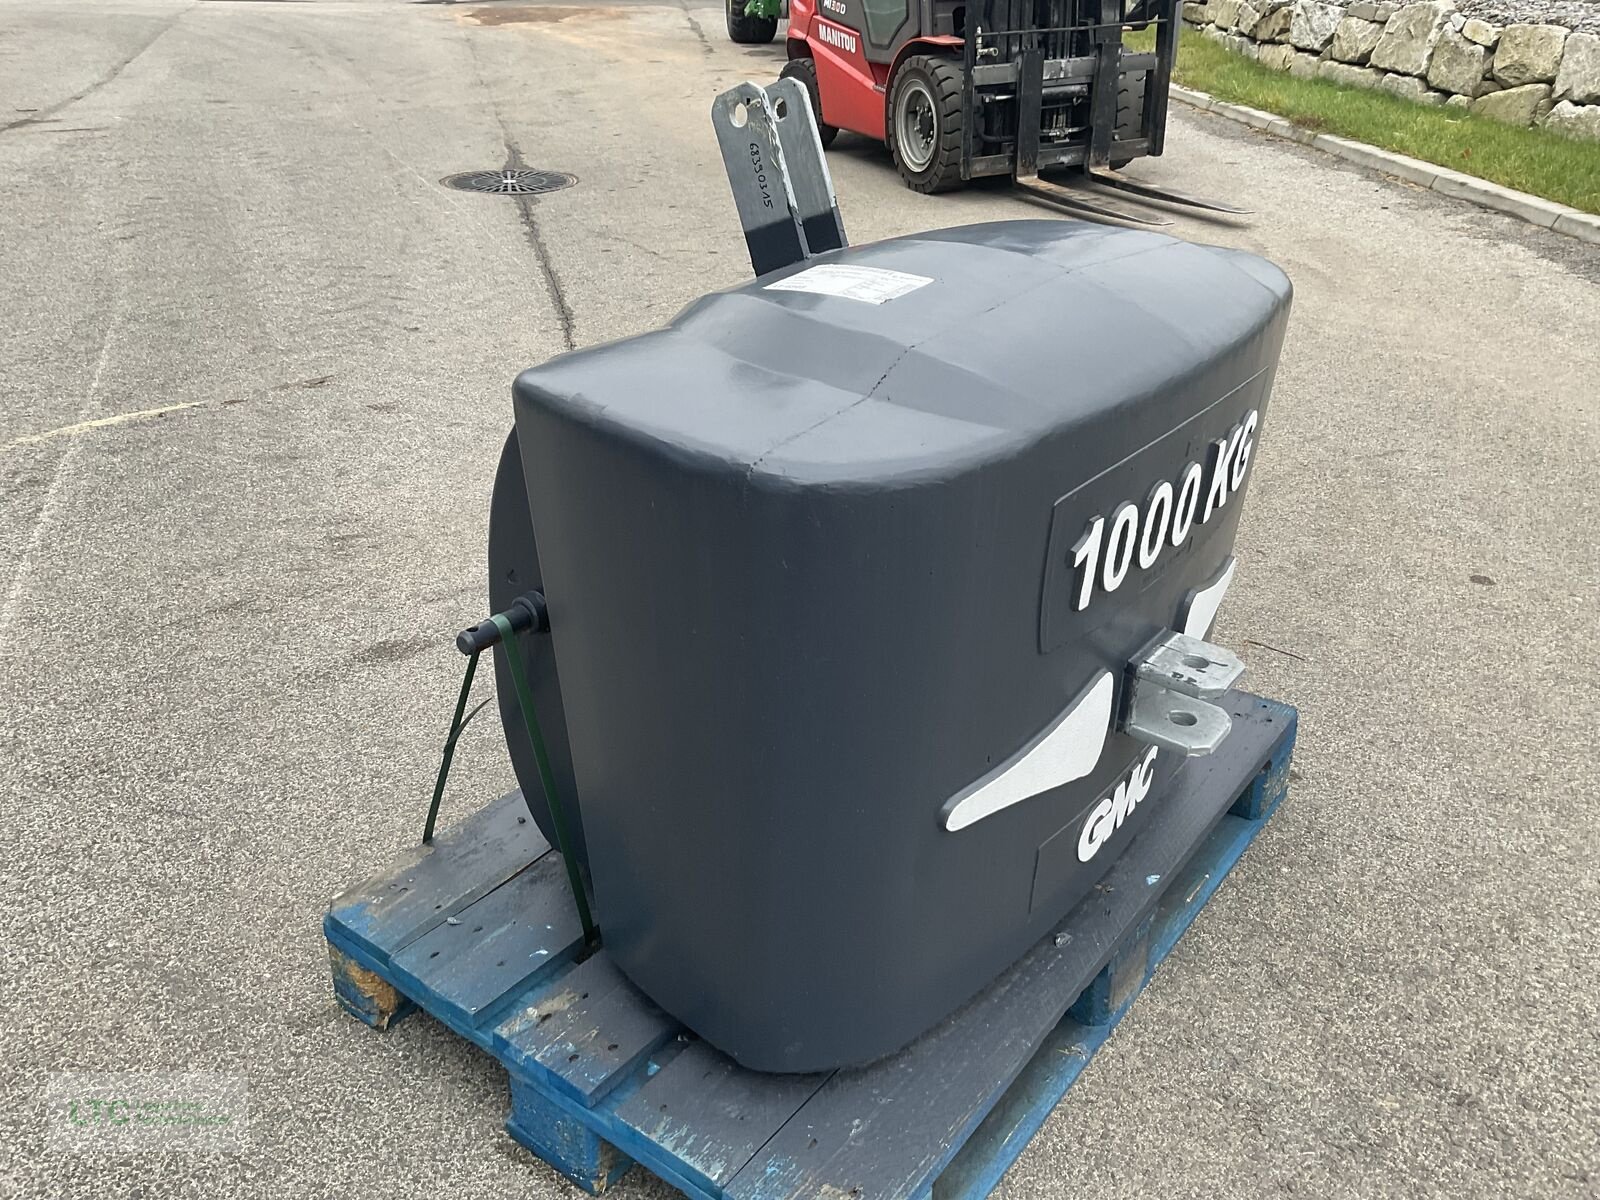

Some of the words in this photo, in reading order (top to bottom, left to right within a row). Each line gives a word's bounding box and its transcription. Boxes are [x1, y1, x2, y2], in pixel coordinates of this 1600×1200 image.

[819, 23, 856, 53] MANITOU
[1072, 462, 1202, 612] 1000
[1202, 408, 1258, 524] KG
[1077, 745, 1159, 863] GMC
